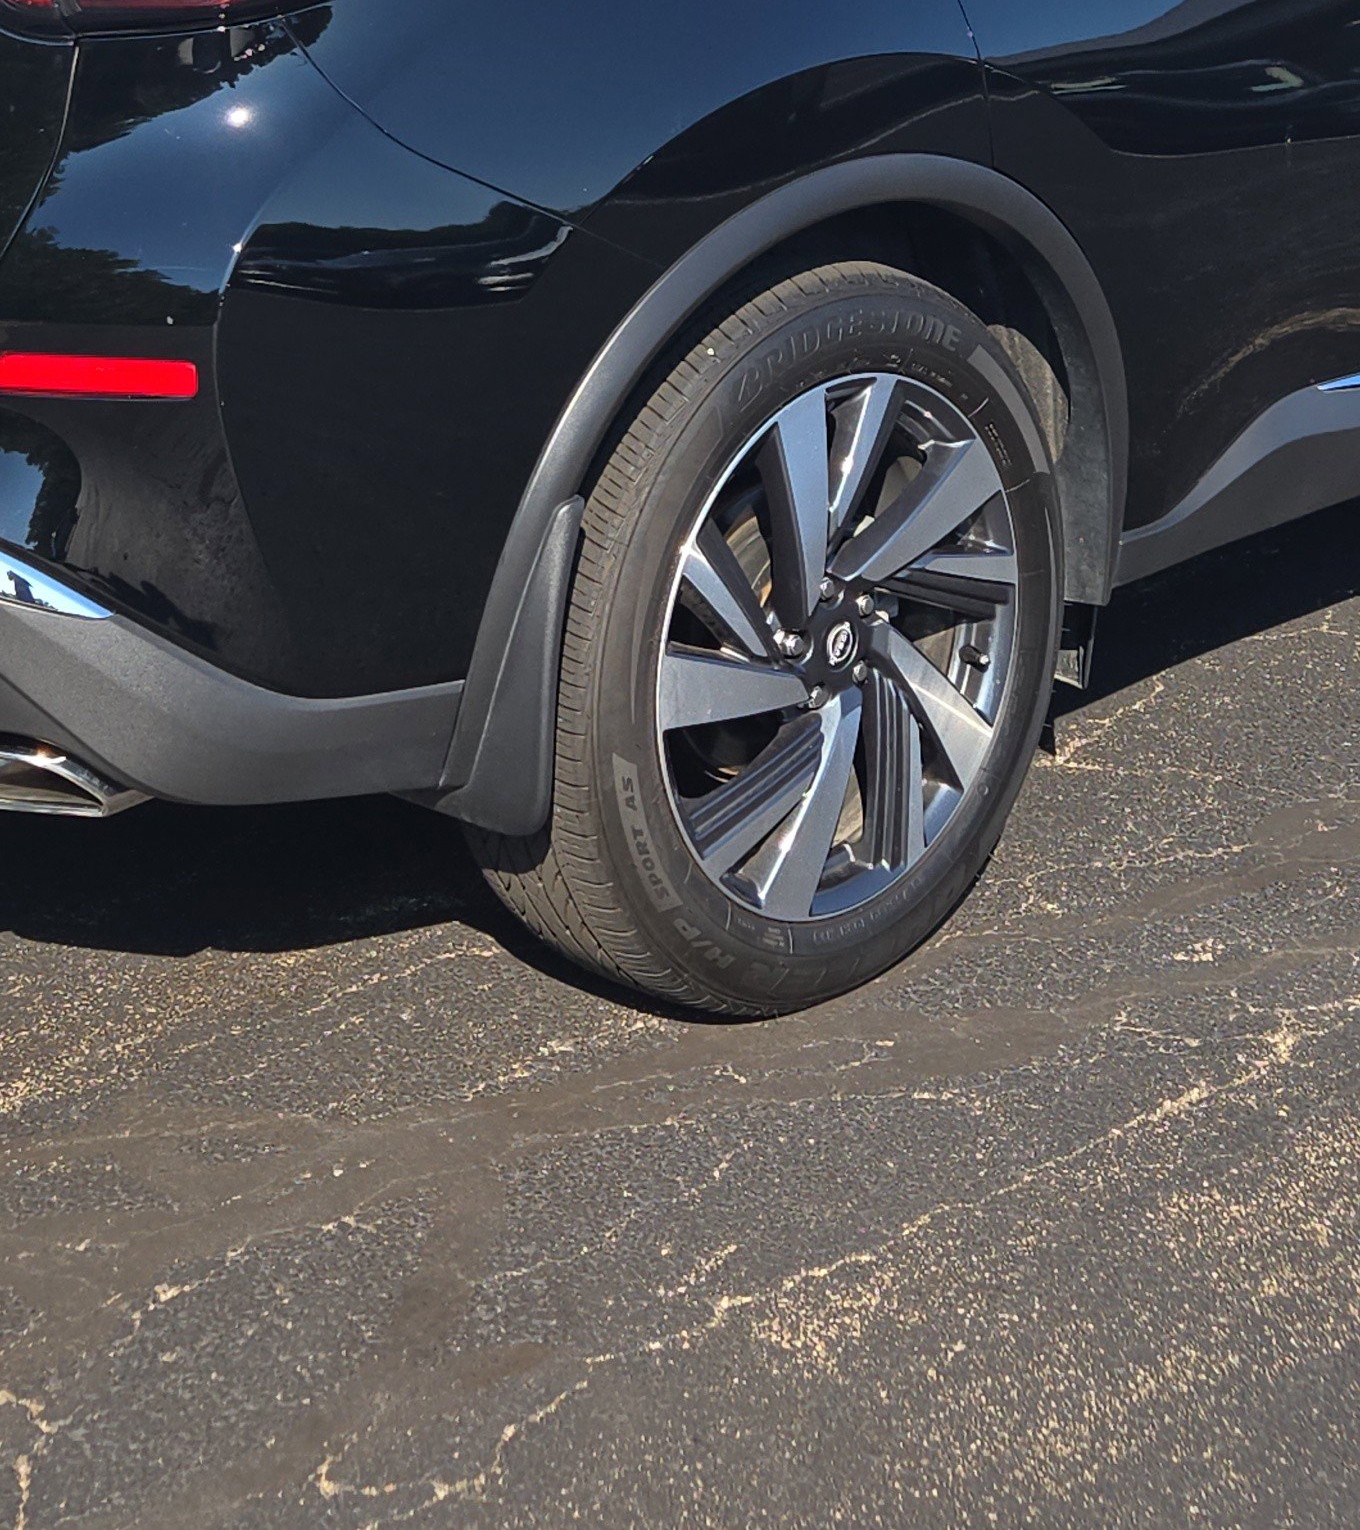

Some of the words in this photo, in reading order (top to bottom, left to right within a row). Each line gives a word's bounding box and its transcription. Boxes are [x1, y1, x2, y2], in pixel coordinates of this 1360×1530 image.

[738, 307, 964, 413] BRIDGESTONE
[621, 774, 639, 812] AS
[631, 826, 670, 902] SPORT
